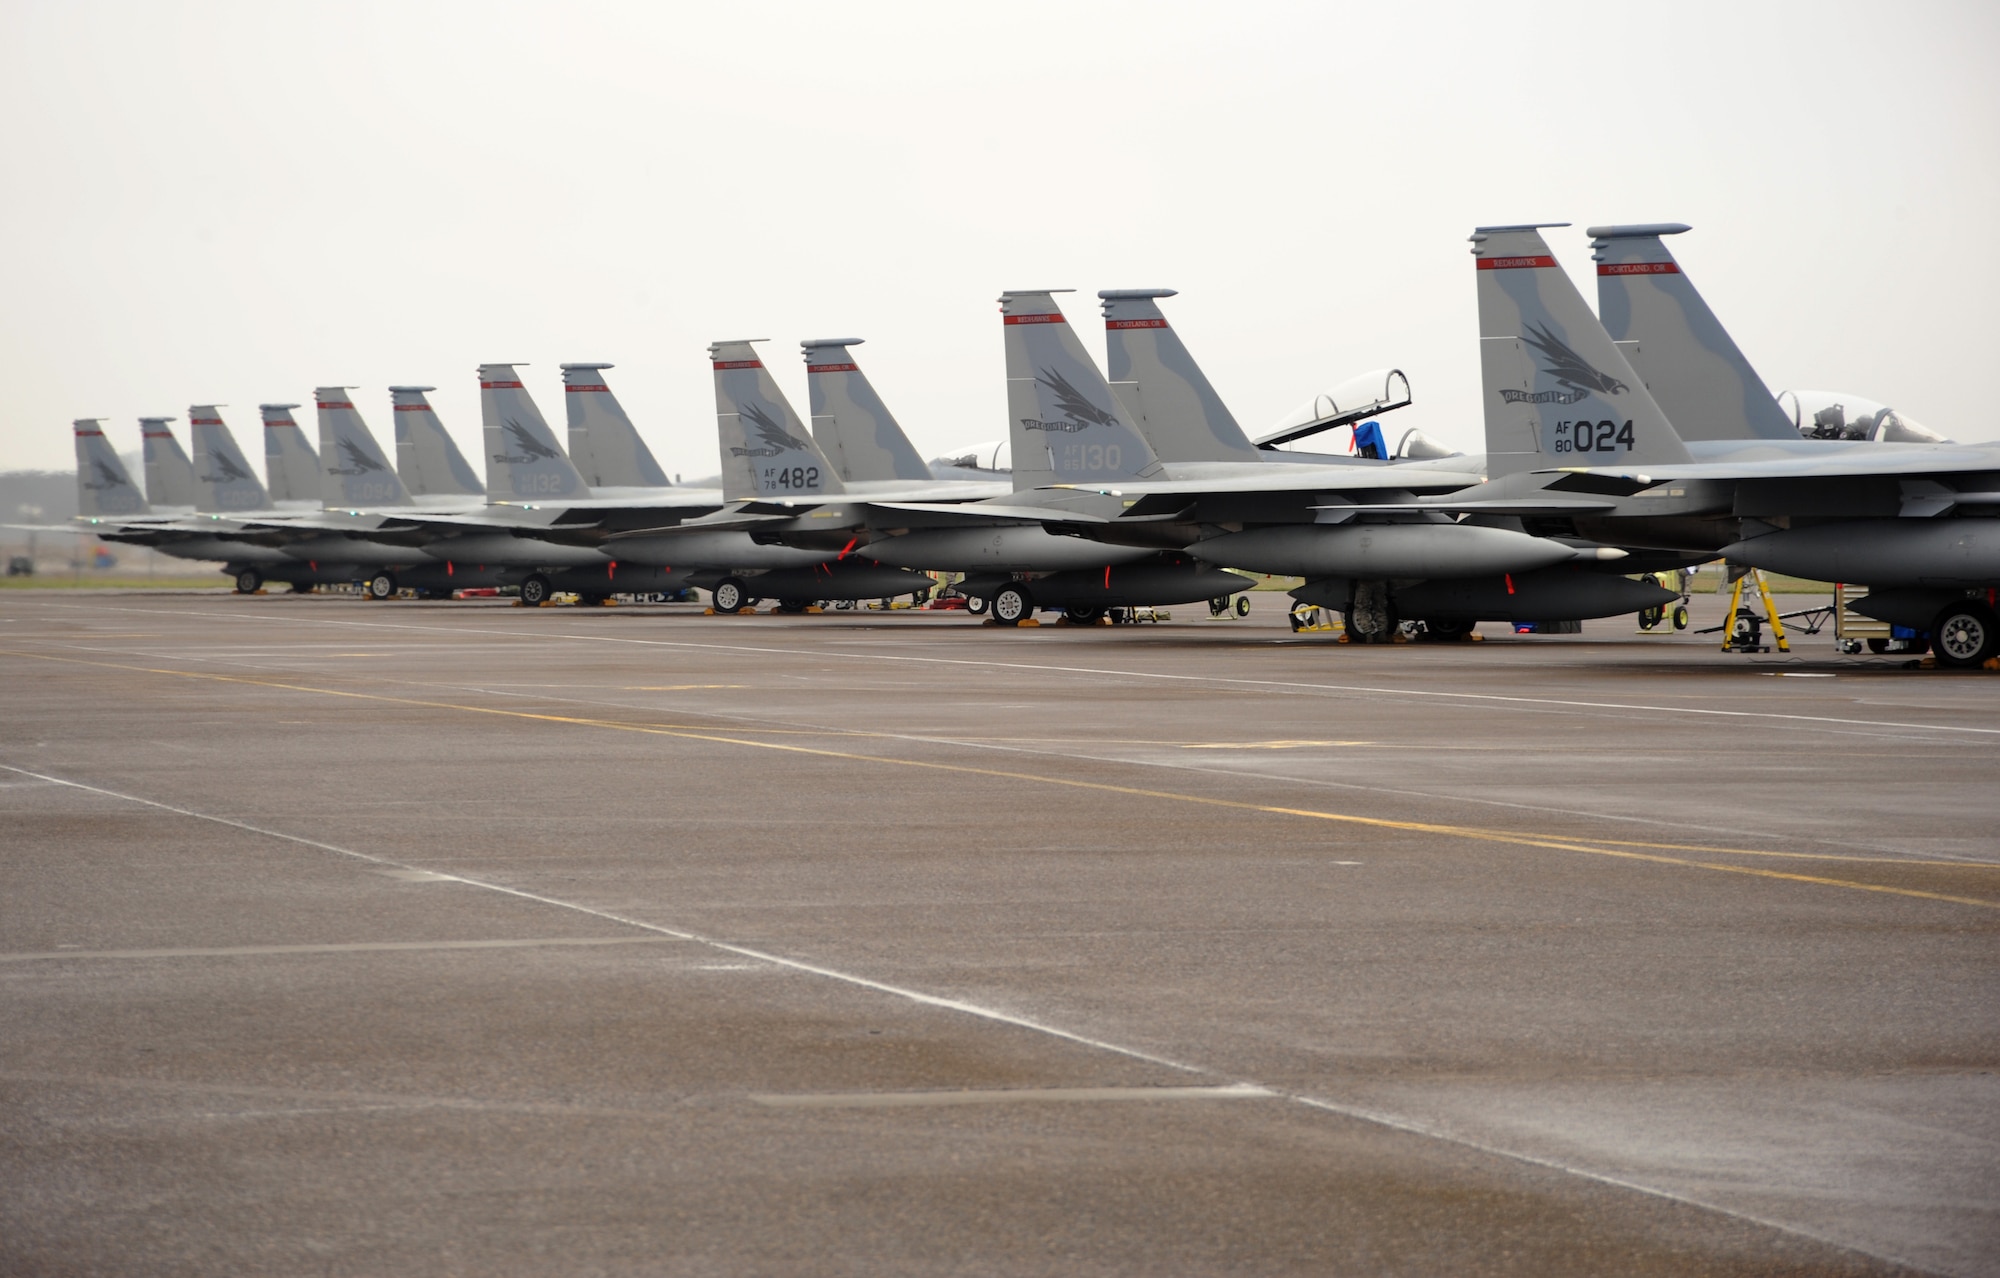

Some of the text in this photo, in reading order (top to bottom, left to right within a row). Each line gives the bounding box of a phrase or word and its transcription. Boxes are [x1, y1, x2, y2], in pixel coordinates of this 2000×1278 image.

[1492, 257, 1537, 268] REDHAWKS
[1653, 263, 1666, 272] OR
[1504, 391, 1548, 404] OREGON
[1555, 421, 1572, 434] AF
[1574, 419, 1635, 452] 024
[1064, 444, 1079, 458] AF
[1555, 439, 1572, 453] 80
[1081, 444, 1121, 471] 130
[1063, 459, 1080, 471] 85
[764, 468, 776, 477] AF
[778, 466, 819, 489] 482
[532, 473, 561, 493] 132
[764, 480, 777, 490] 78
